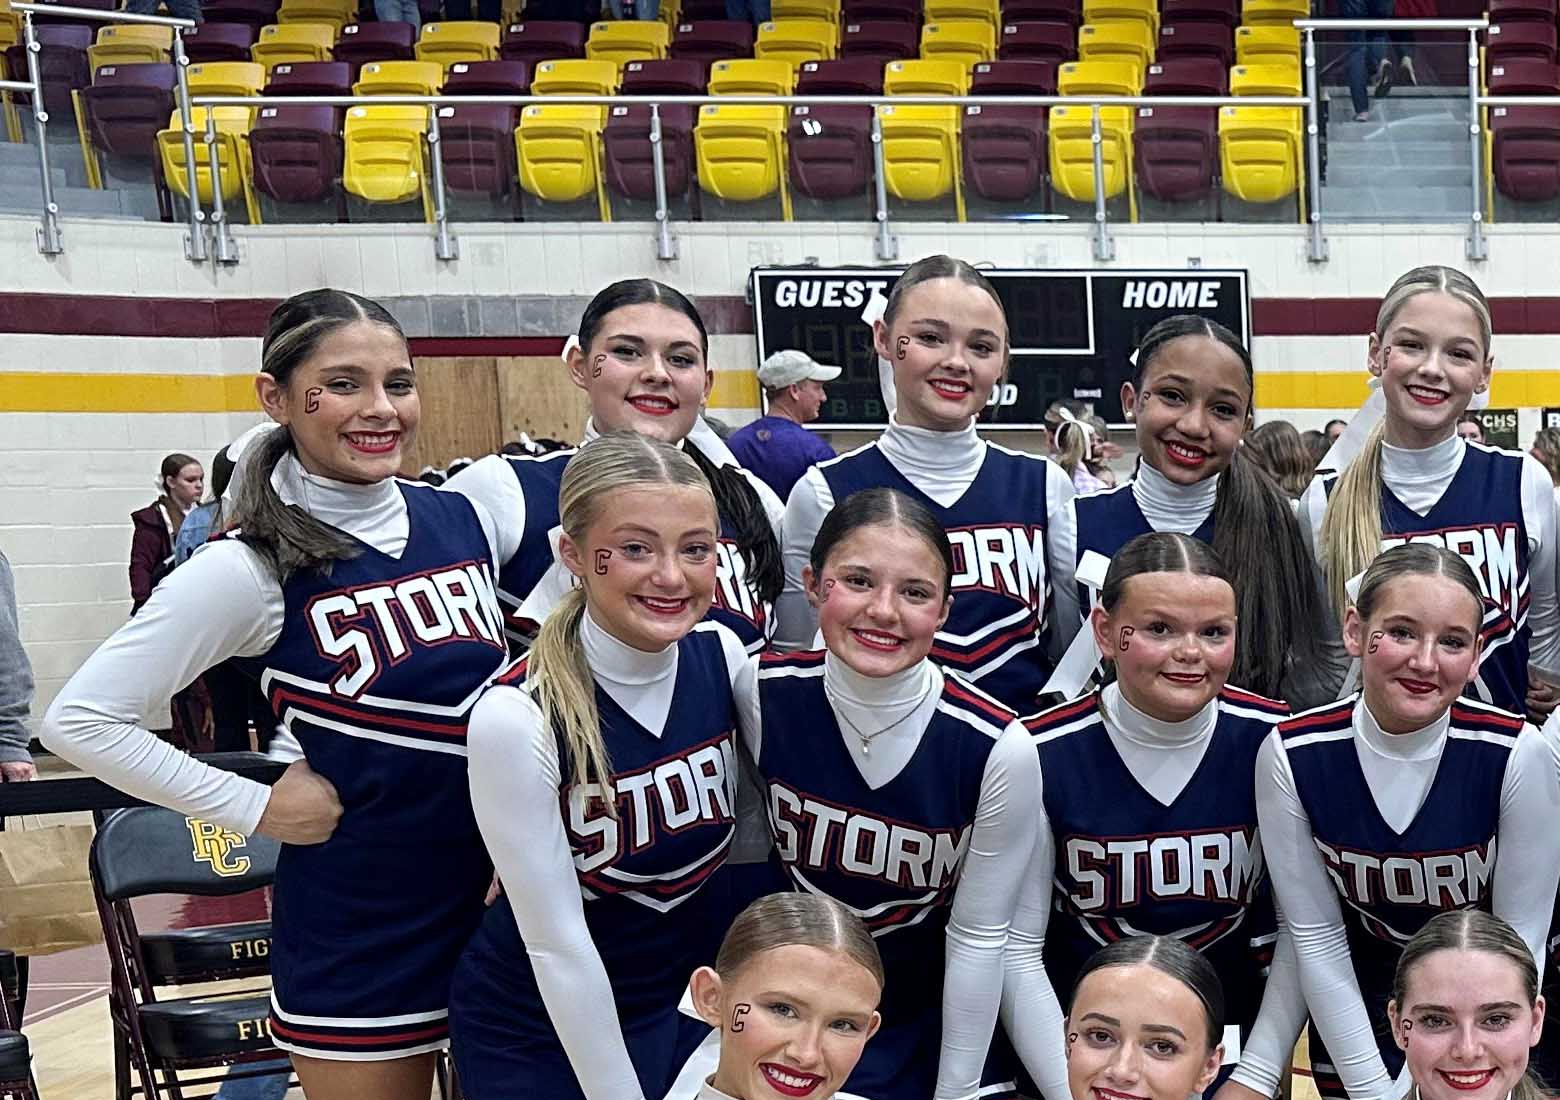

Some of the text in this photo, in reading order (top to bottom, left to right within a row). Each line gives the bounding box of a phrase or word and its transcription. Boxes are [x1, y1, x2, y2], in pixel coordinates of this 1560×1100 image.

[775, 280, 887, 308] GUEST
[1122, 280, 1221, 308] HOME
[1474, 413, 1517, 428] CHS
[946, 525, 1046, 624] ORM
[1067, 826, 1260, 910] STORM
[230, 938, 271, 960] FIG
[731, 1003, 750, 1033] C
